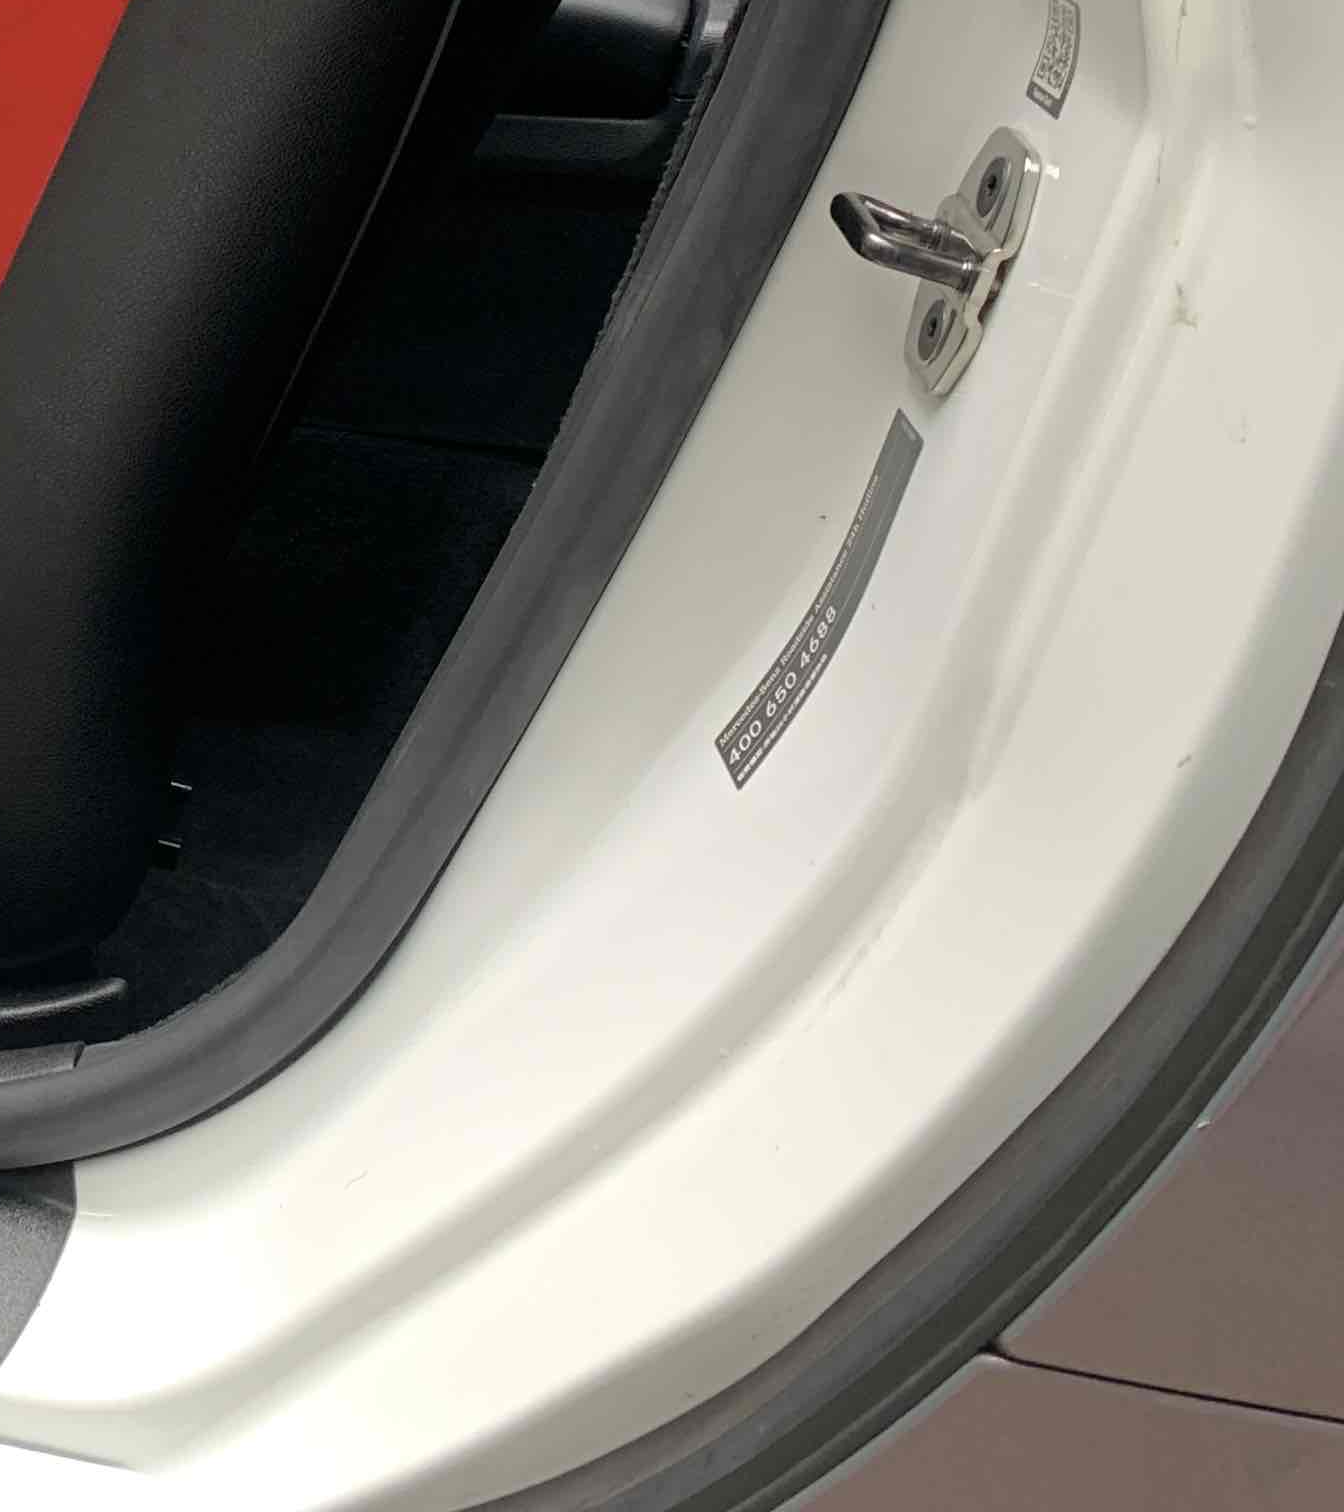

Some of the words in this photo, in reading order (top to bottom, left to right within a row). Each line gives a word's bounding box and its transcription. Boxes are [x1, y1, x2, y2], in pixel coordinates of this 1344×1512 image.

[728, 719, 762, 764] 400
[766, 671, 797, 716] 650
[800, 606, 837, 668] 4688
